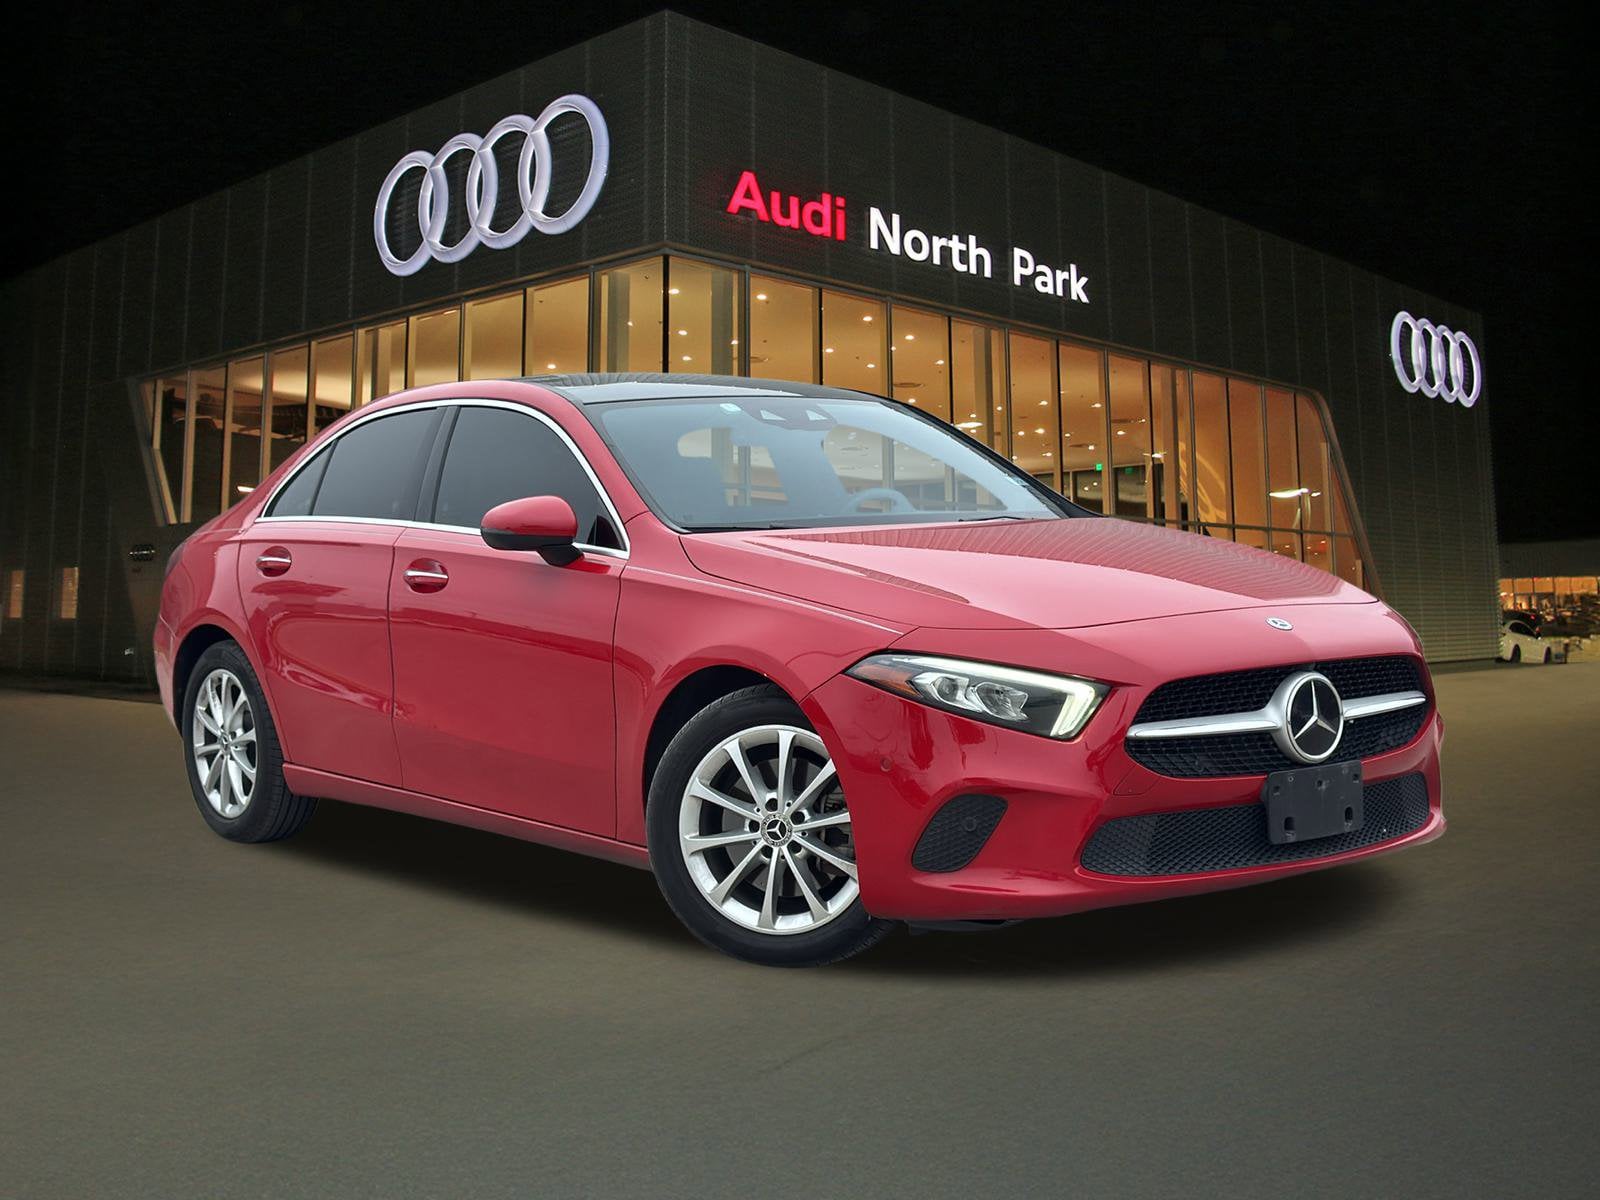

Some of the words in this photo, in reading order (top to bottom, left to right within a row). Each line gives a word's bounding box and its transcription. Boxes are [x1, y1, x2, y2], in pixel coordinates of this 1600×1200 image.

[727, 171, 846, 241] Audi
[869, 206, 992, 278] North
[1013, 247, 1090, 303] Park
